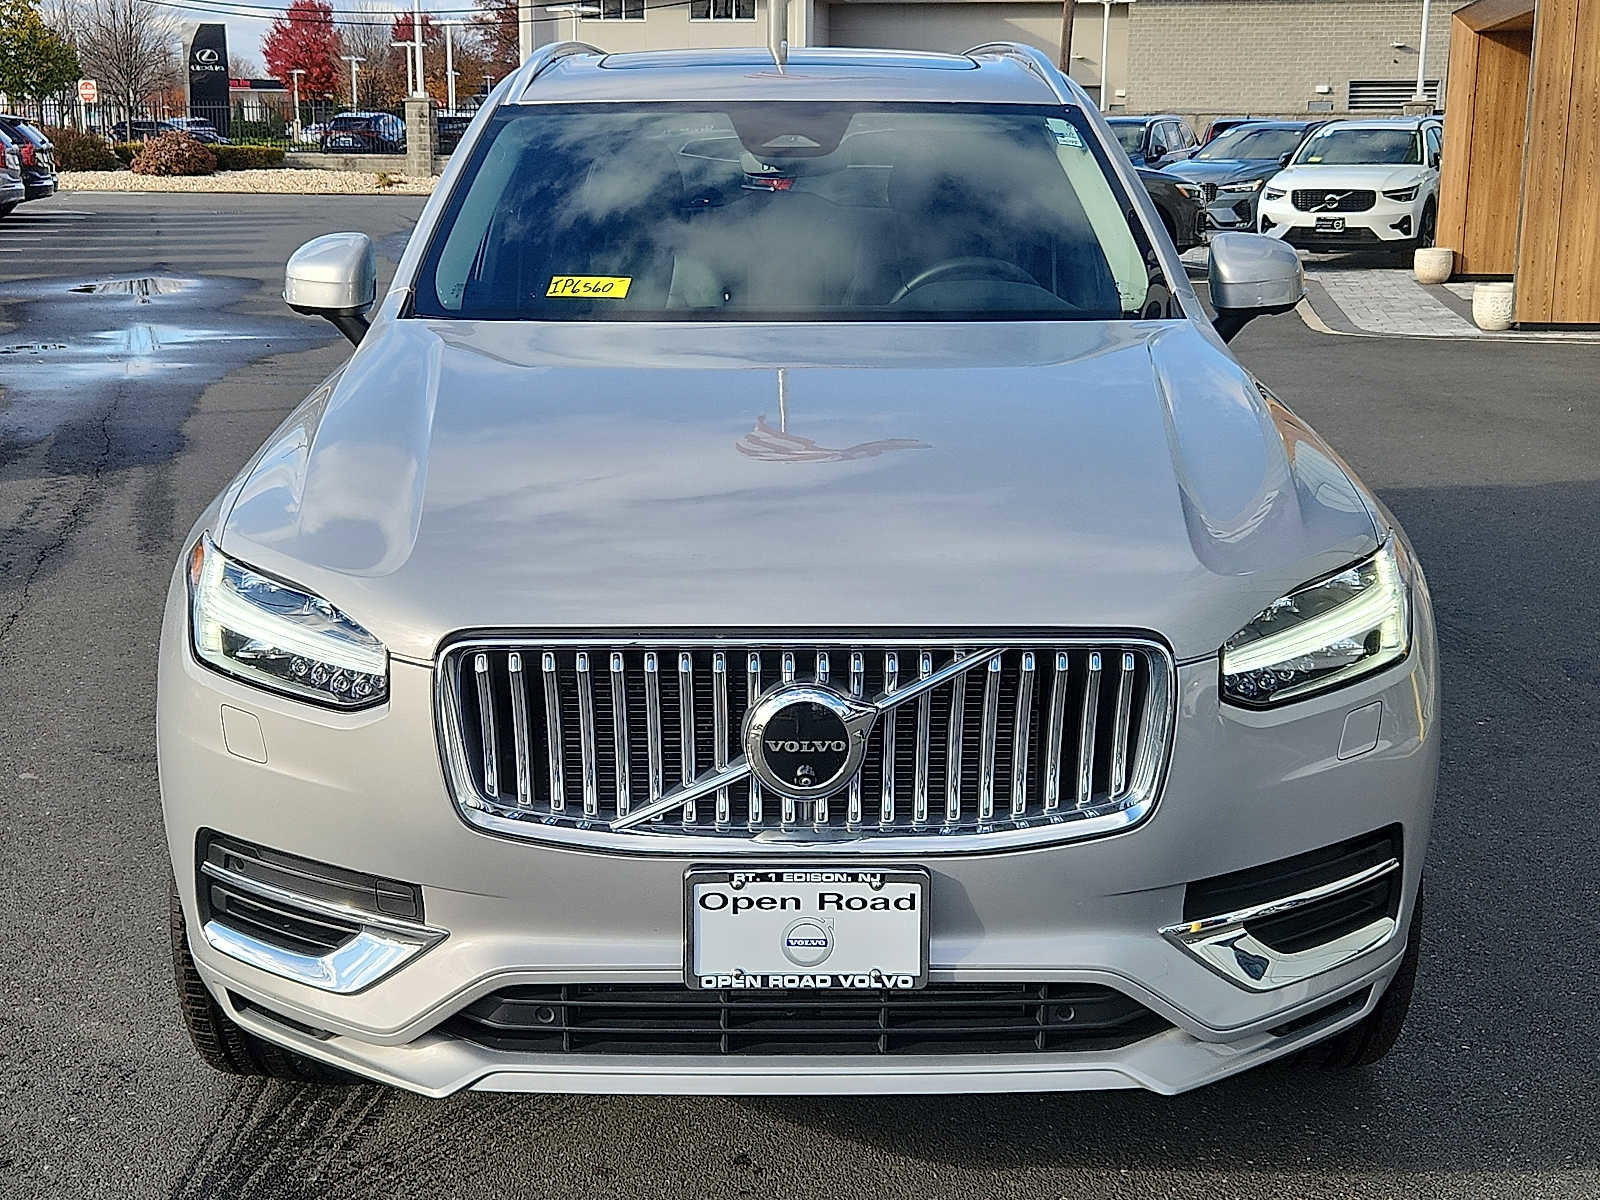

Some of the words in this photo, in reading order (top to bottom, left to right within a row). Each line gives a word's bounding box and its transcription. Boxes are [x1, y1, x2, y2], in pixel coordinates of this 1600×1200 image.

[764, 740, 846, 752] VOLVO
[768, 872, 776, 882] 1
[858, 872, 881, 882] NJ
[698, 892, 801, 914] Open
[818, 892, 916, 911] Road
[701, 975, 761, 988] OPEN
[769, 975, 832, 988] ROAD
[838, 975, 914, 988] VOLVO
